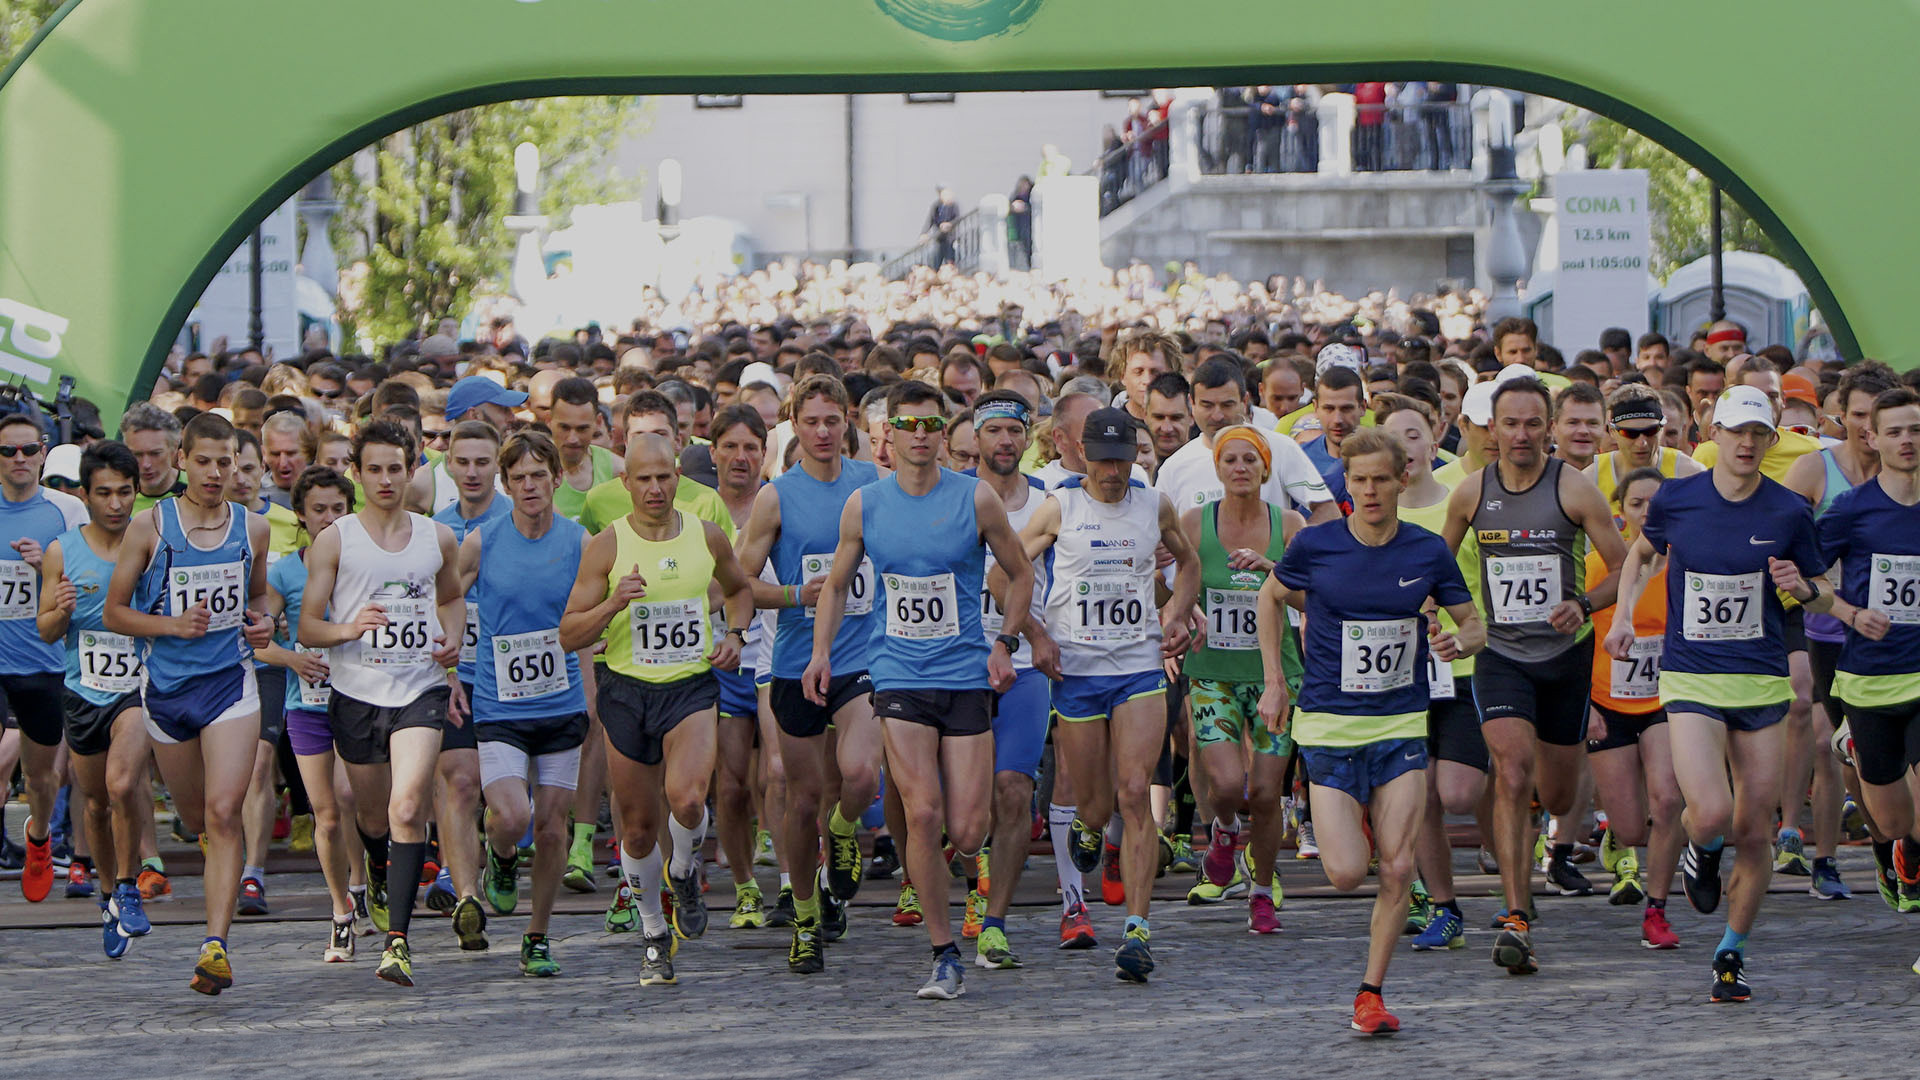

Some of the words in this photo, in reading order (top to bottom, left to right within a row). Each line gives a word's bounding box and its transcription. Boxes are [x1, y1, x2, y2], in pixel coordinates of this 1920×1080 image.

[1565, 197, 1621, 213] CONA
[1629, 198, 1637, 213] 1
[1575, 228, 1604, 241] 12.5
[1608, 228, 1630, 241] km
[1562, 258, 1585, 271] pod
[1590, 256, 1641, 268] 1:05:00
[1511, 529, 1557, 539] POLAR
[2, 581, 31, 605] 75
[176, 584, 239, 613] 1565
[851, 572, 865, 599] 0
[1500, 577, 1549, 607] 745
[1883, 577, 1920, 607] 36
[896, 596, 944, 624] 650
[980, 589, 1004, 615] 1
[1077, 598, 1142, 627] 1160
[1697, 597, 1749, 624] 367
[371, 620, 428, 649] 1565
[636, 619, 700, 650] 1565
[1212, 608, 1257, 635] 118
[508, 650, 555, 683] 650
[1356, 642, 1406, 675] 367
